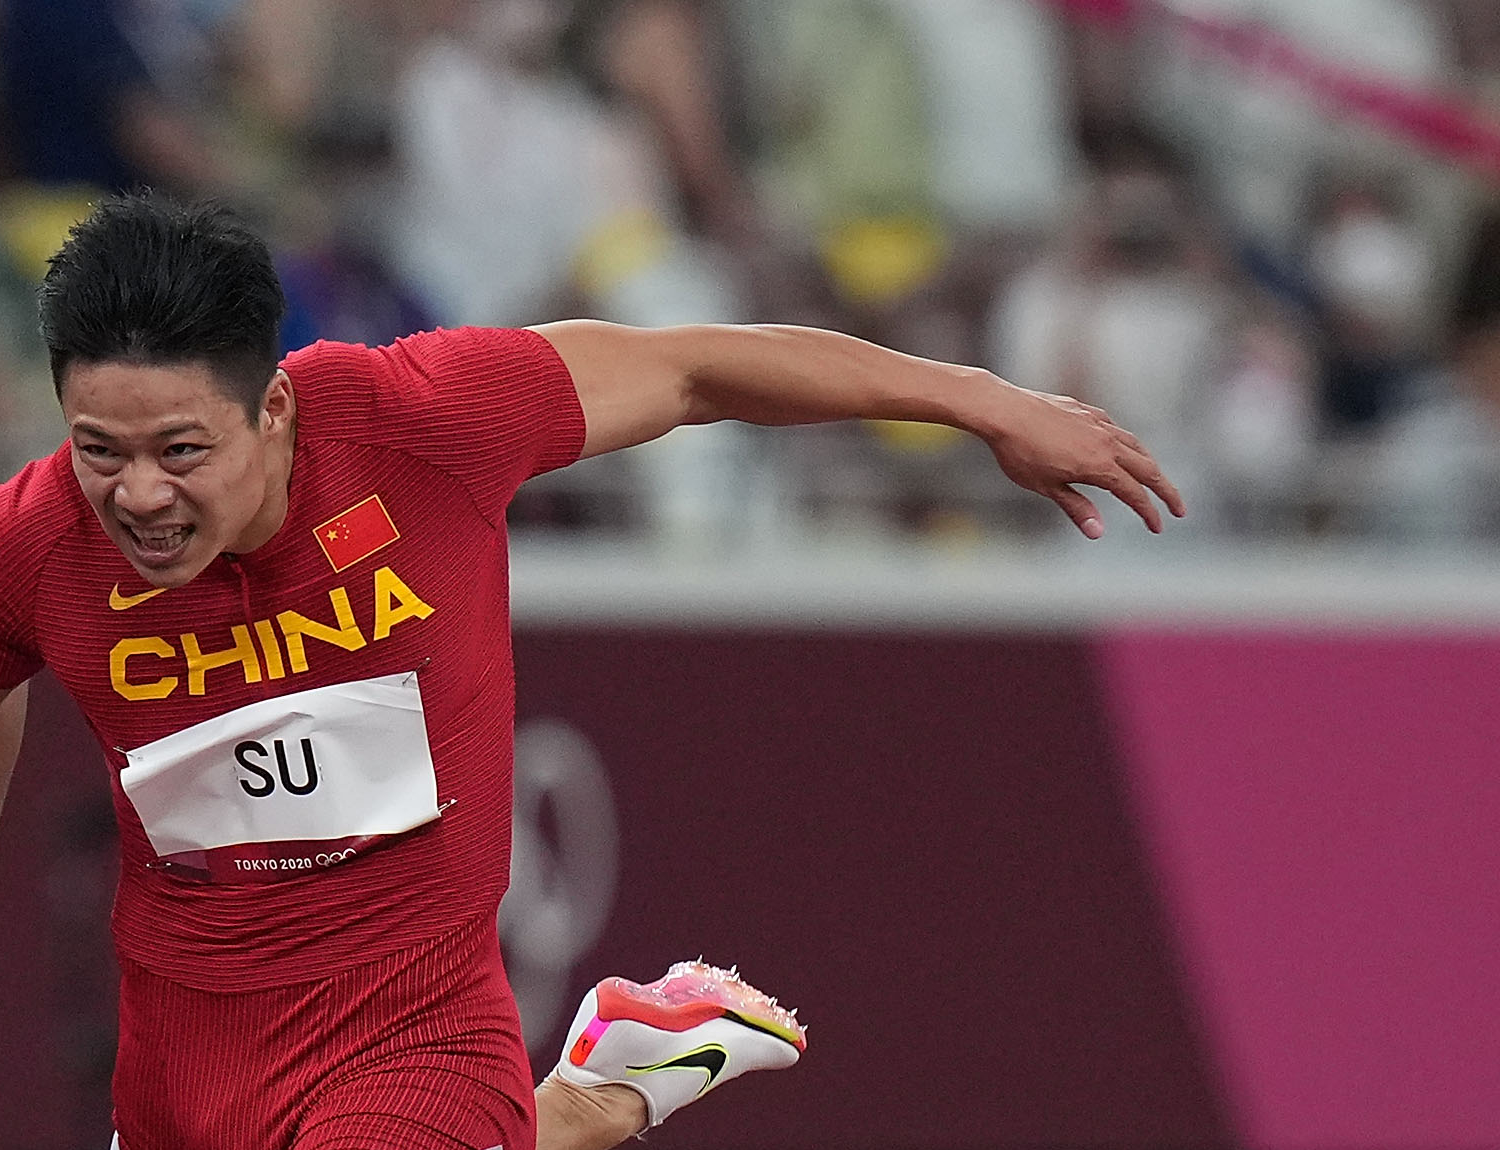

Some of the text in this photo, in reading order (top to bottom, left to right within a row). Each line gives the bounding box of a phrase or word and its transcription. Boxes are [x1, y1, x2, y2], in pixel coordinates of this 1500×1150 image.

[109, 567, 436, 702] CHINA
[233, 738, 319, 798] SU
[234, 857, 312, 871] TOKYO 2020
